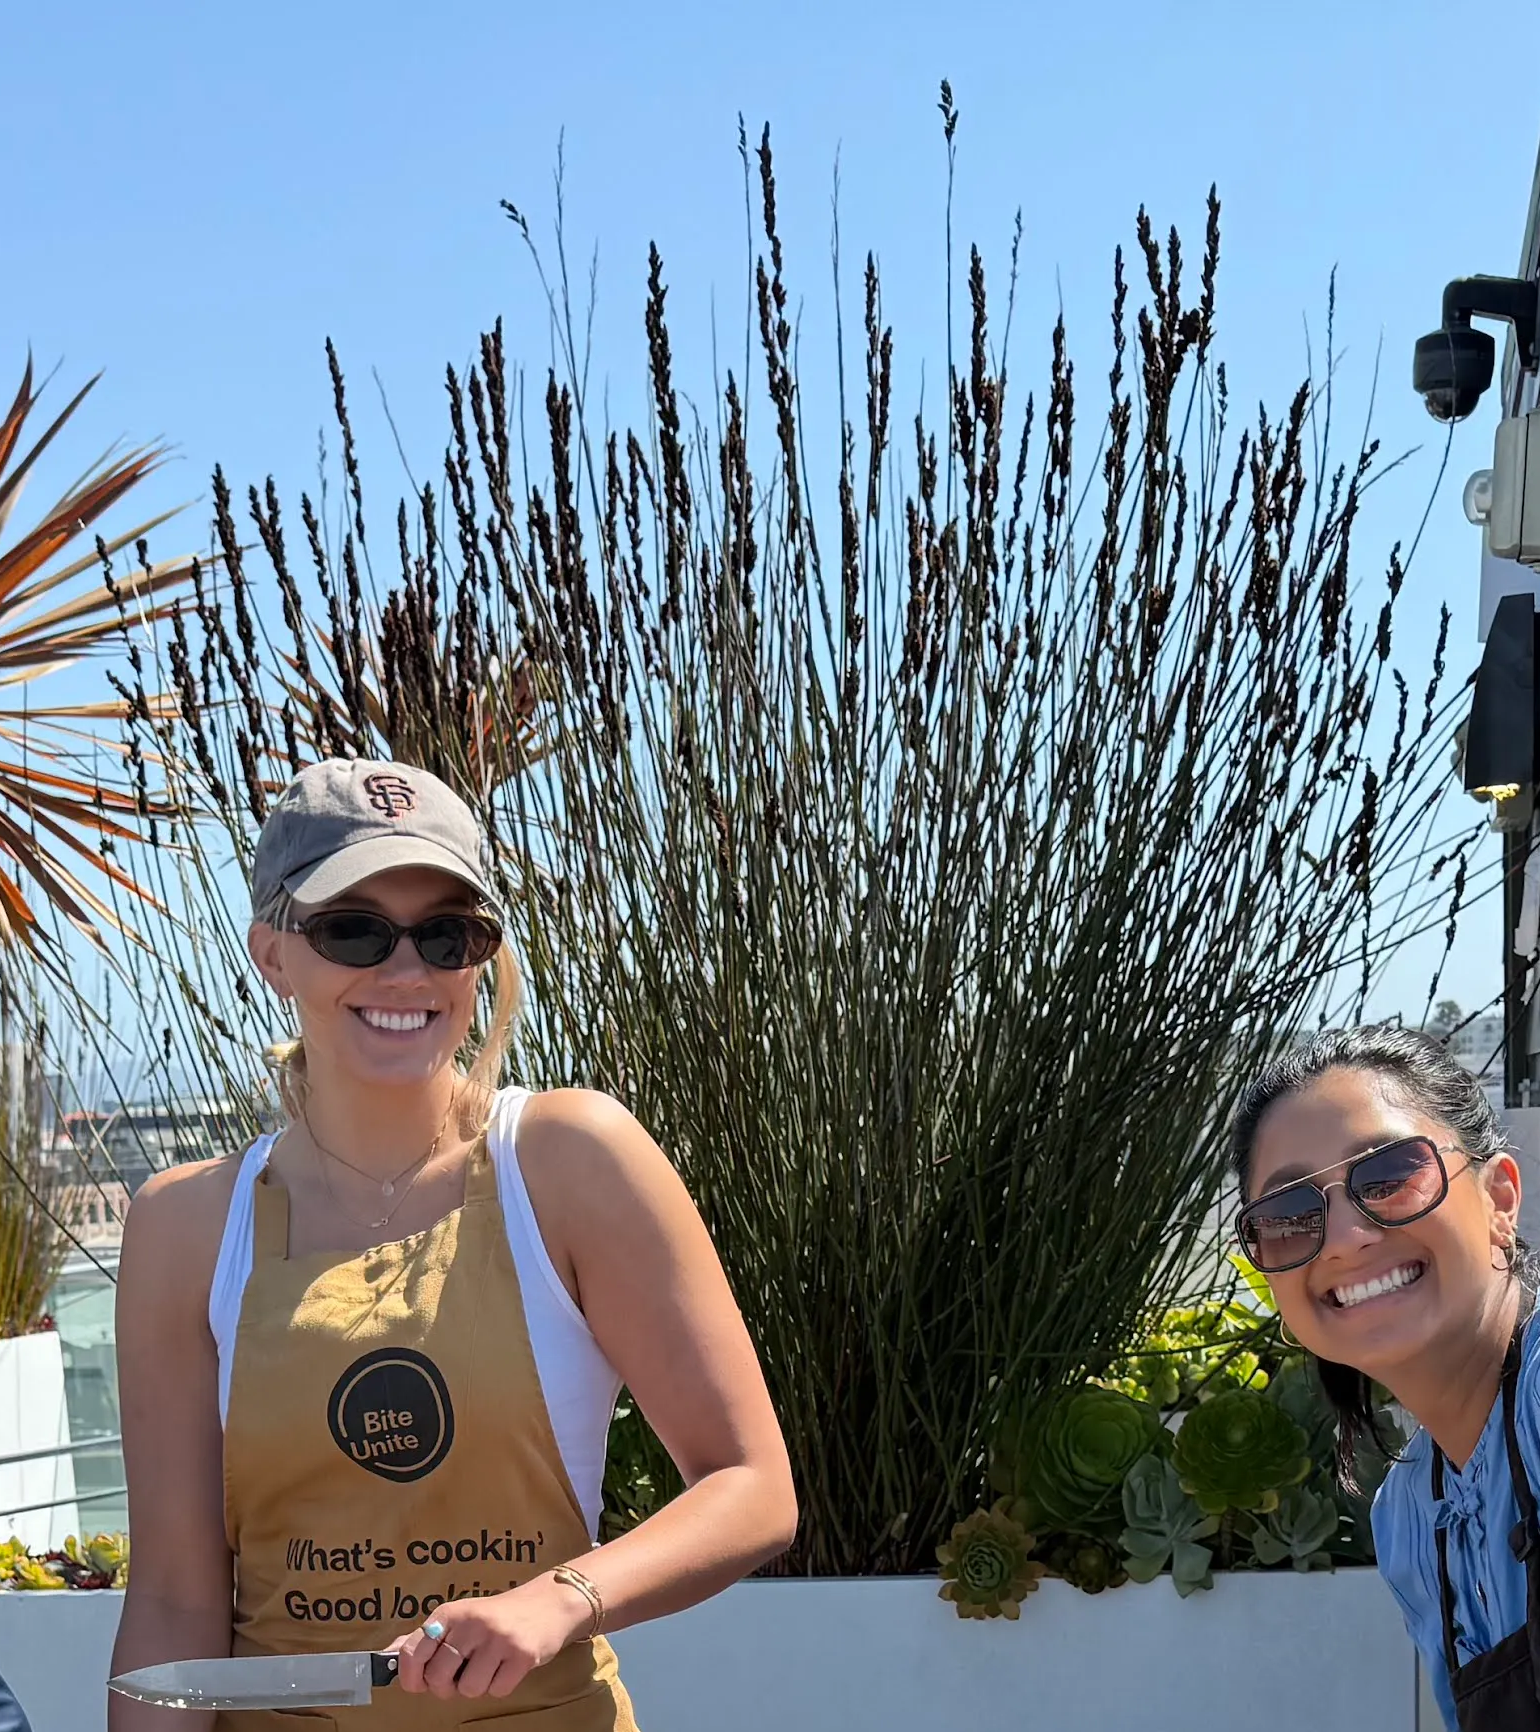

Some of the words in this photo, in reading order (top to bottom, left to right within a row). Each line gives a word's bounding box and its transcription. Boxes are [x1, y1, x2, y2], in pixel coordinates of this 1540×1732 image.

[364, 1410, 413, 1434] Bite
[350, 1434, 419, 1460] Unite
[407, 1529, 544, 1564] cookin'
[284, 1588, 382, 1622] Good
